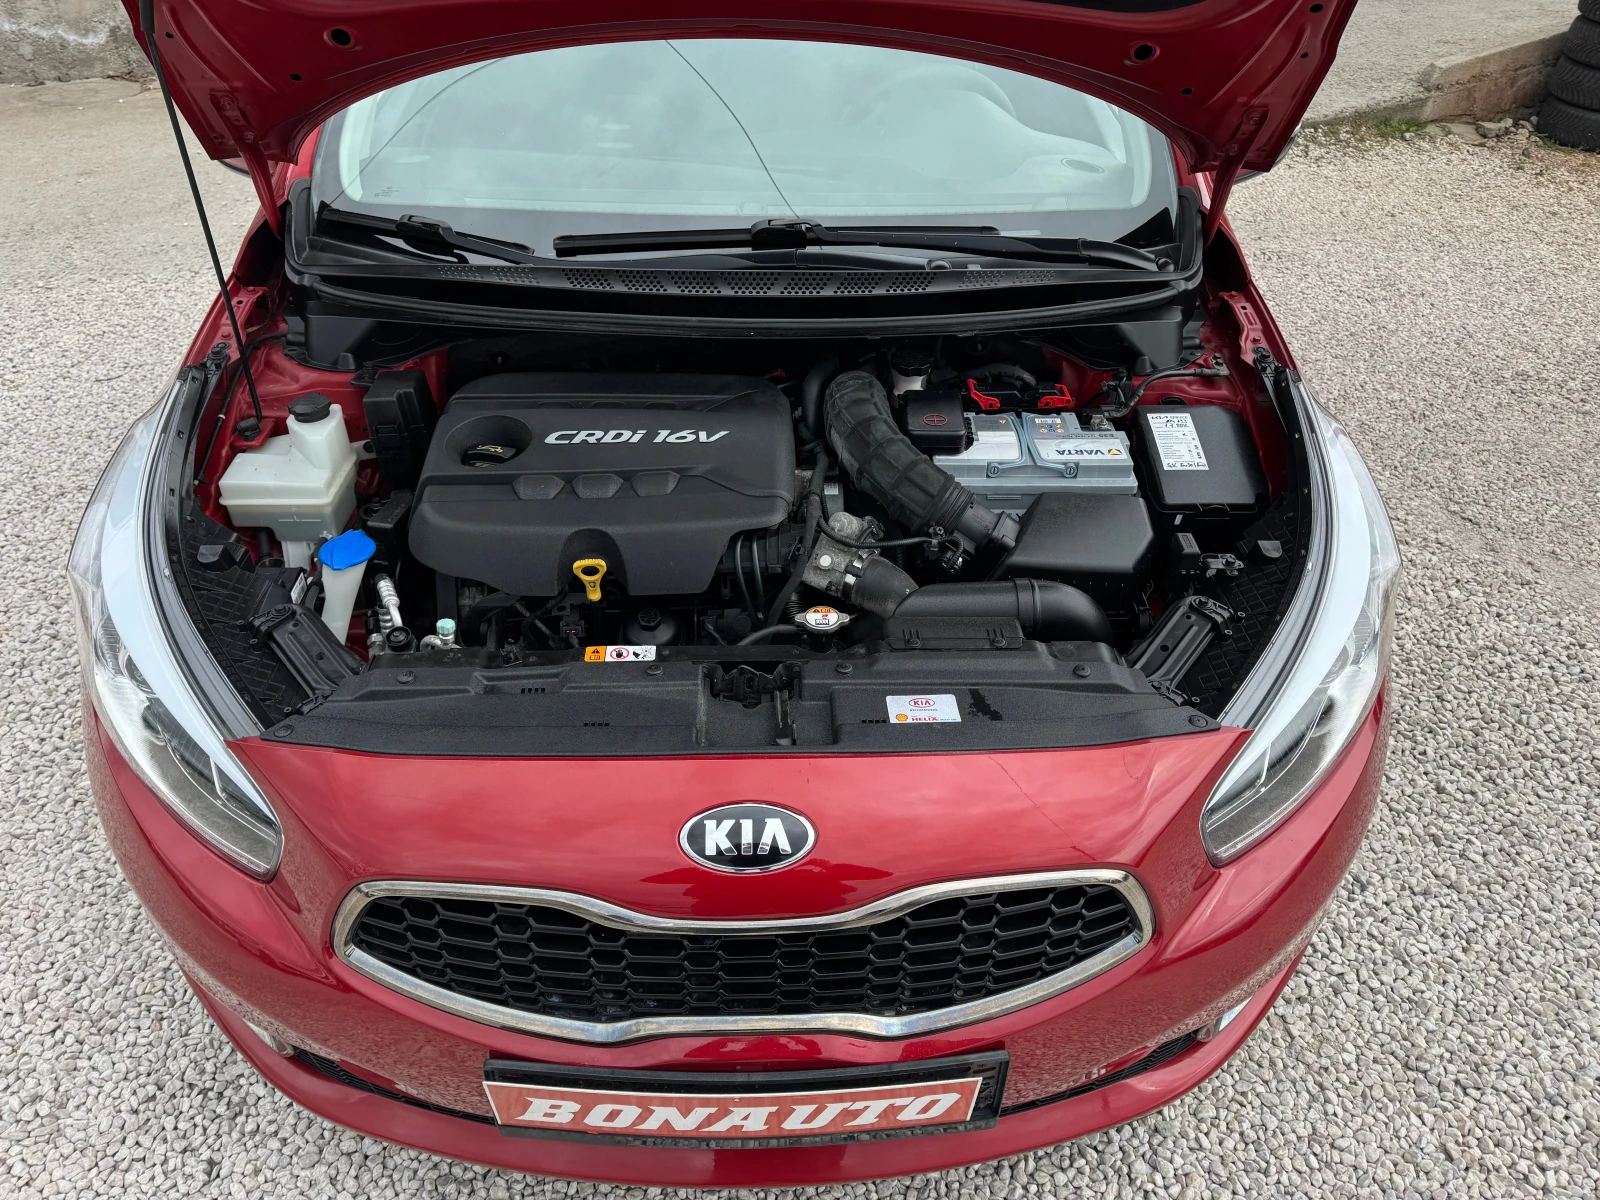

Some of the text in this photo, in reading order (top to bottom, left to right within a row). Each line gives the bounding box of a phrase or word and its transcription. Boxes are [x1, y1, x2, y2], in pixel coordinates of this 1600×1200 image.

[544, 429, 730, 444] CRDi 16V
[703, 818, 792, 856] KIA
[515, 1092, 962, 1132] BONAUTO
